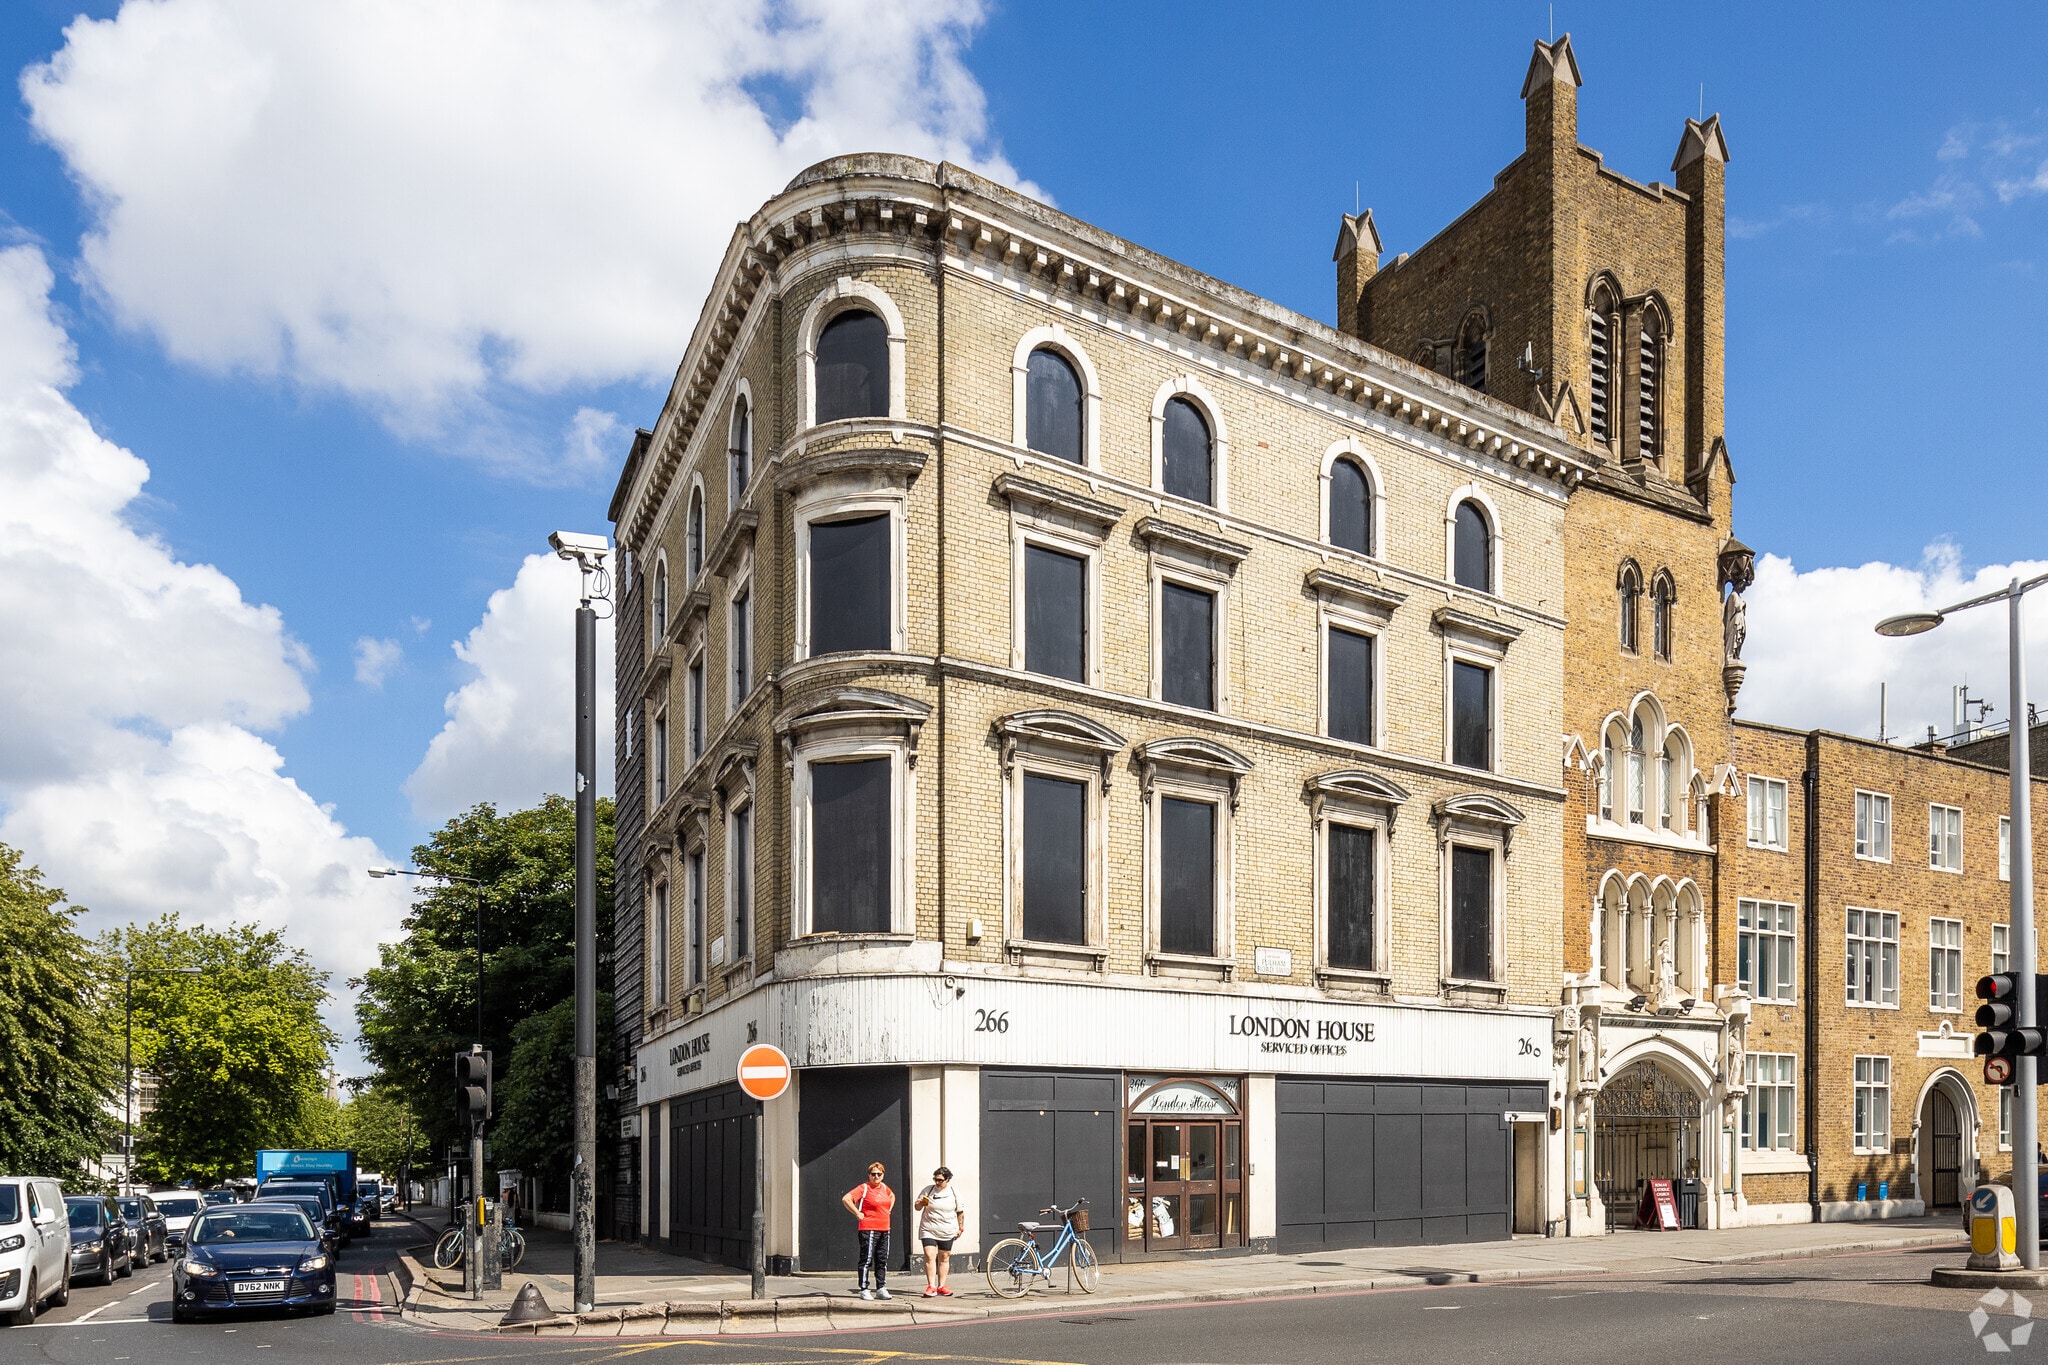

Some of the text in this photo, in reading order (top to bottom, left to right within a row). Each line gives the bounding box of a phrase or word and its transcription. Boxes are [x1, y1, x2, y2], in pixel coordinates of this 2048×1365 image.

[974, 1008, 1010, 1034] 266
[1229, 1014, 1376, 1043] LONDON HOUSE
[669, 1032, 711, 1066] LONDON HOUSE
[1261, 1041, 1348, 1056] SERVICED OFFICES
[1129, 1078, 1146, 1089] 266
[1223, 1080, 1239, 1091] 266
[1150, 1094, 1219, 1109] London House
[238, 1282, 281, 1292] DV62 NNK
